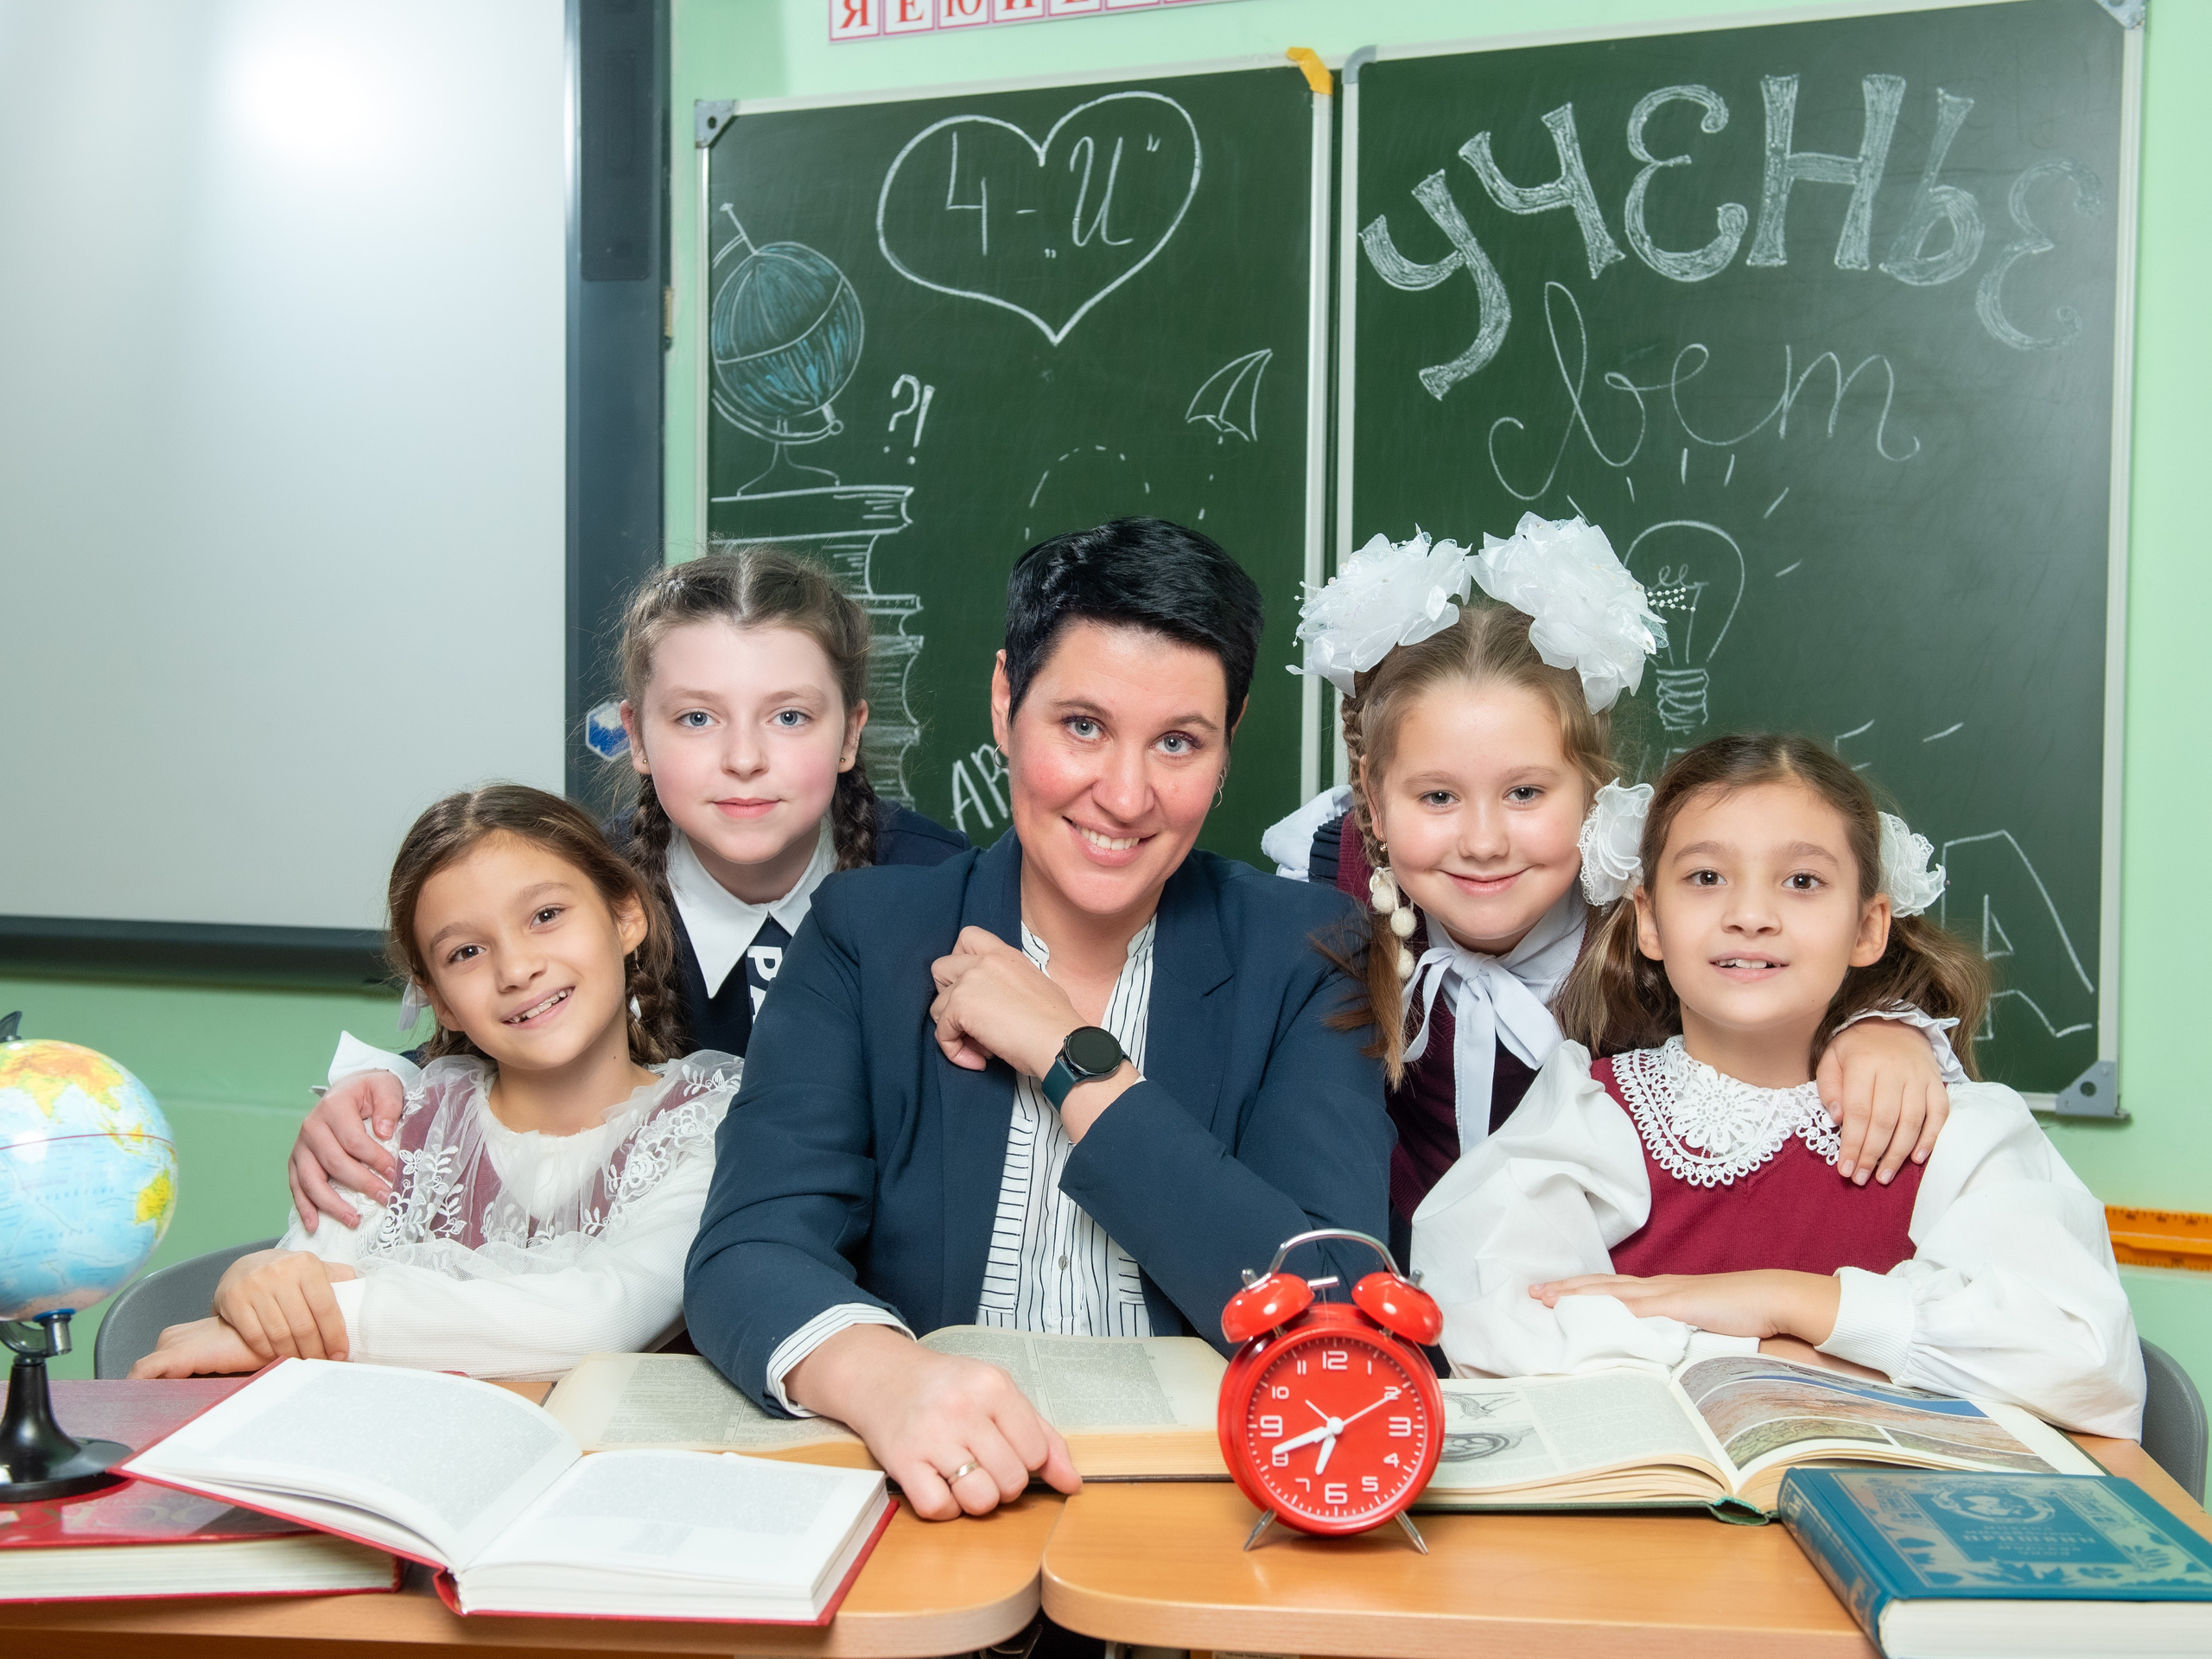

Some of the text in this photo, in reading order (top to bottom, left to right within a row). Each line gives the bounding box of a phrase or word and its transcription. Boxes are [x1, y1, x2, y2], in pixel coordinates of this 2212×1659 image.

[1297, 1360, 1306, 1376] 11
[1322, 1351, 1348, 1370] 12
[1272, 1386, 1289, 1400] 10
[1260, 1415, 1283, 1438] 9
[1389, 1416, 1412, 1437] 3
[1383, 1452, 1400, 1468] 4
[1294, 1478, 1310, 1492] 7
[1362, 1476, 1378, 1492] 5
[1325, 1483, 1348, 1504] 6
